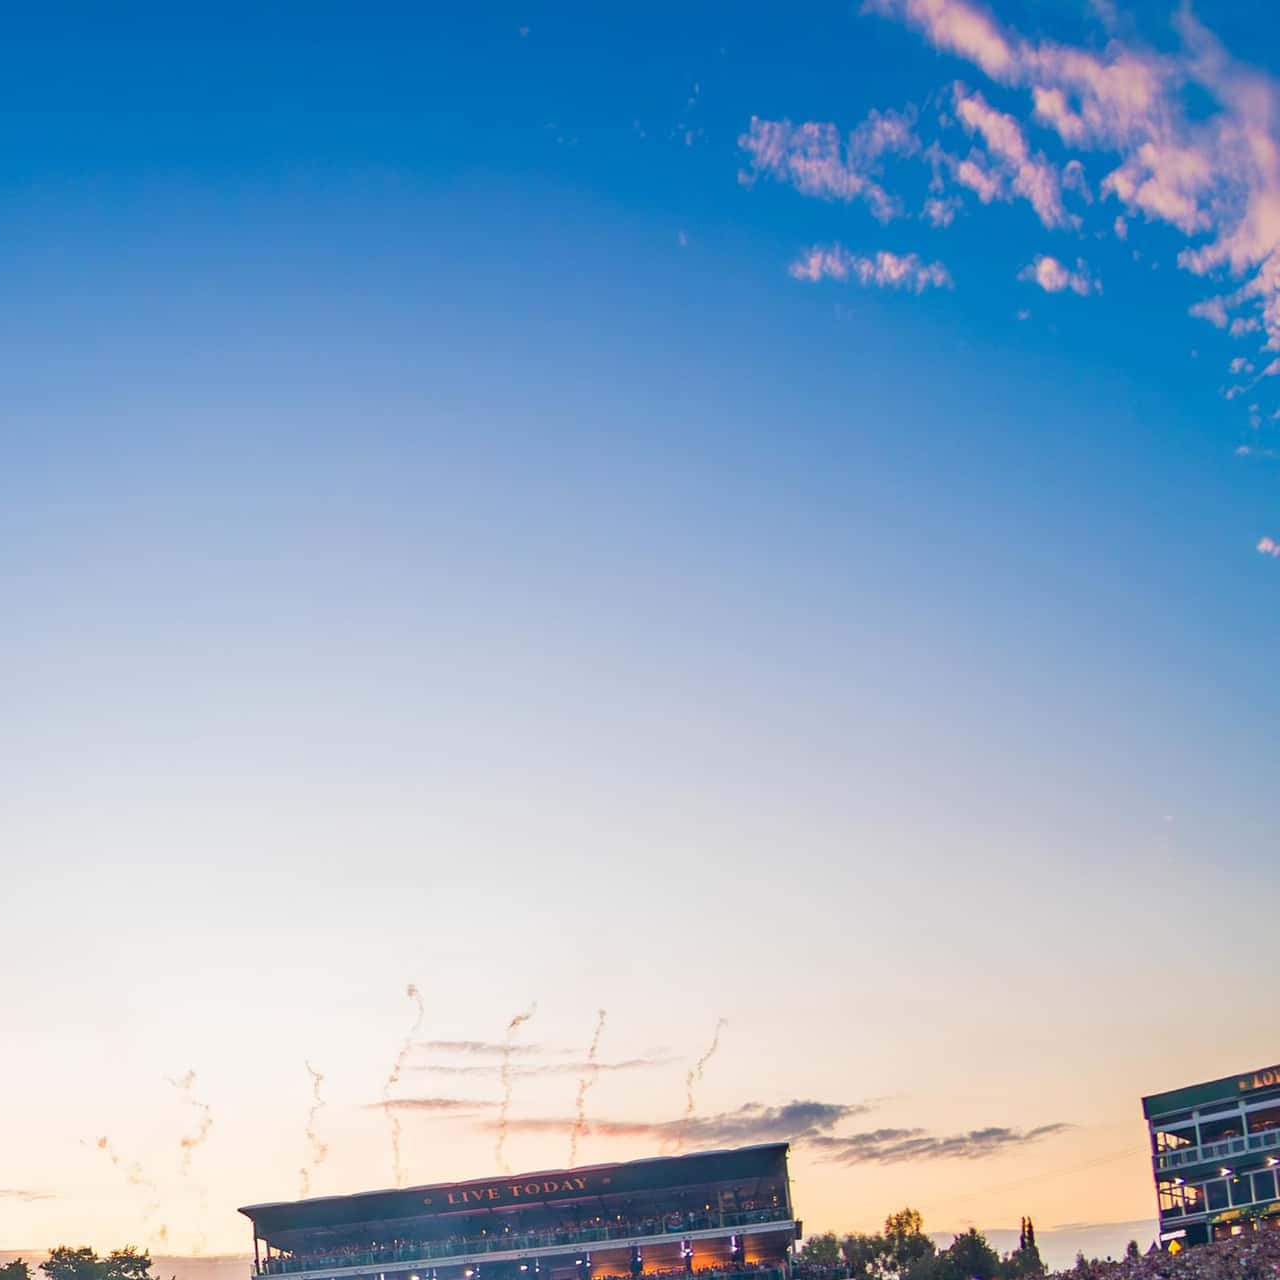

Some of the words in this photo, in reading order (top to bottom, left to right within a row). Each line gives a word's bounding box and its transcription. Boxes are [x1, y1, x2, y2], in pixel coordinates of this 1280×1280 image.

[1253, 1071, 1280, 1089] LO
[447, 1187, 501, 1205] LIVE
[507, 1177, 587, 1198] TODAY
